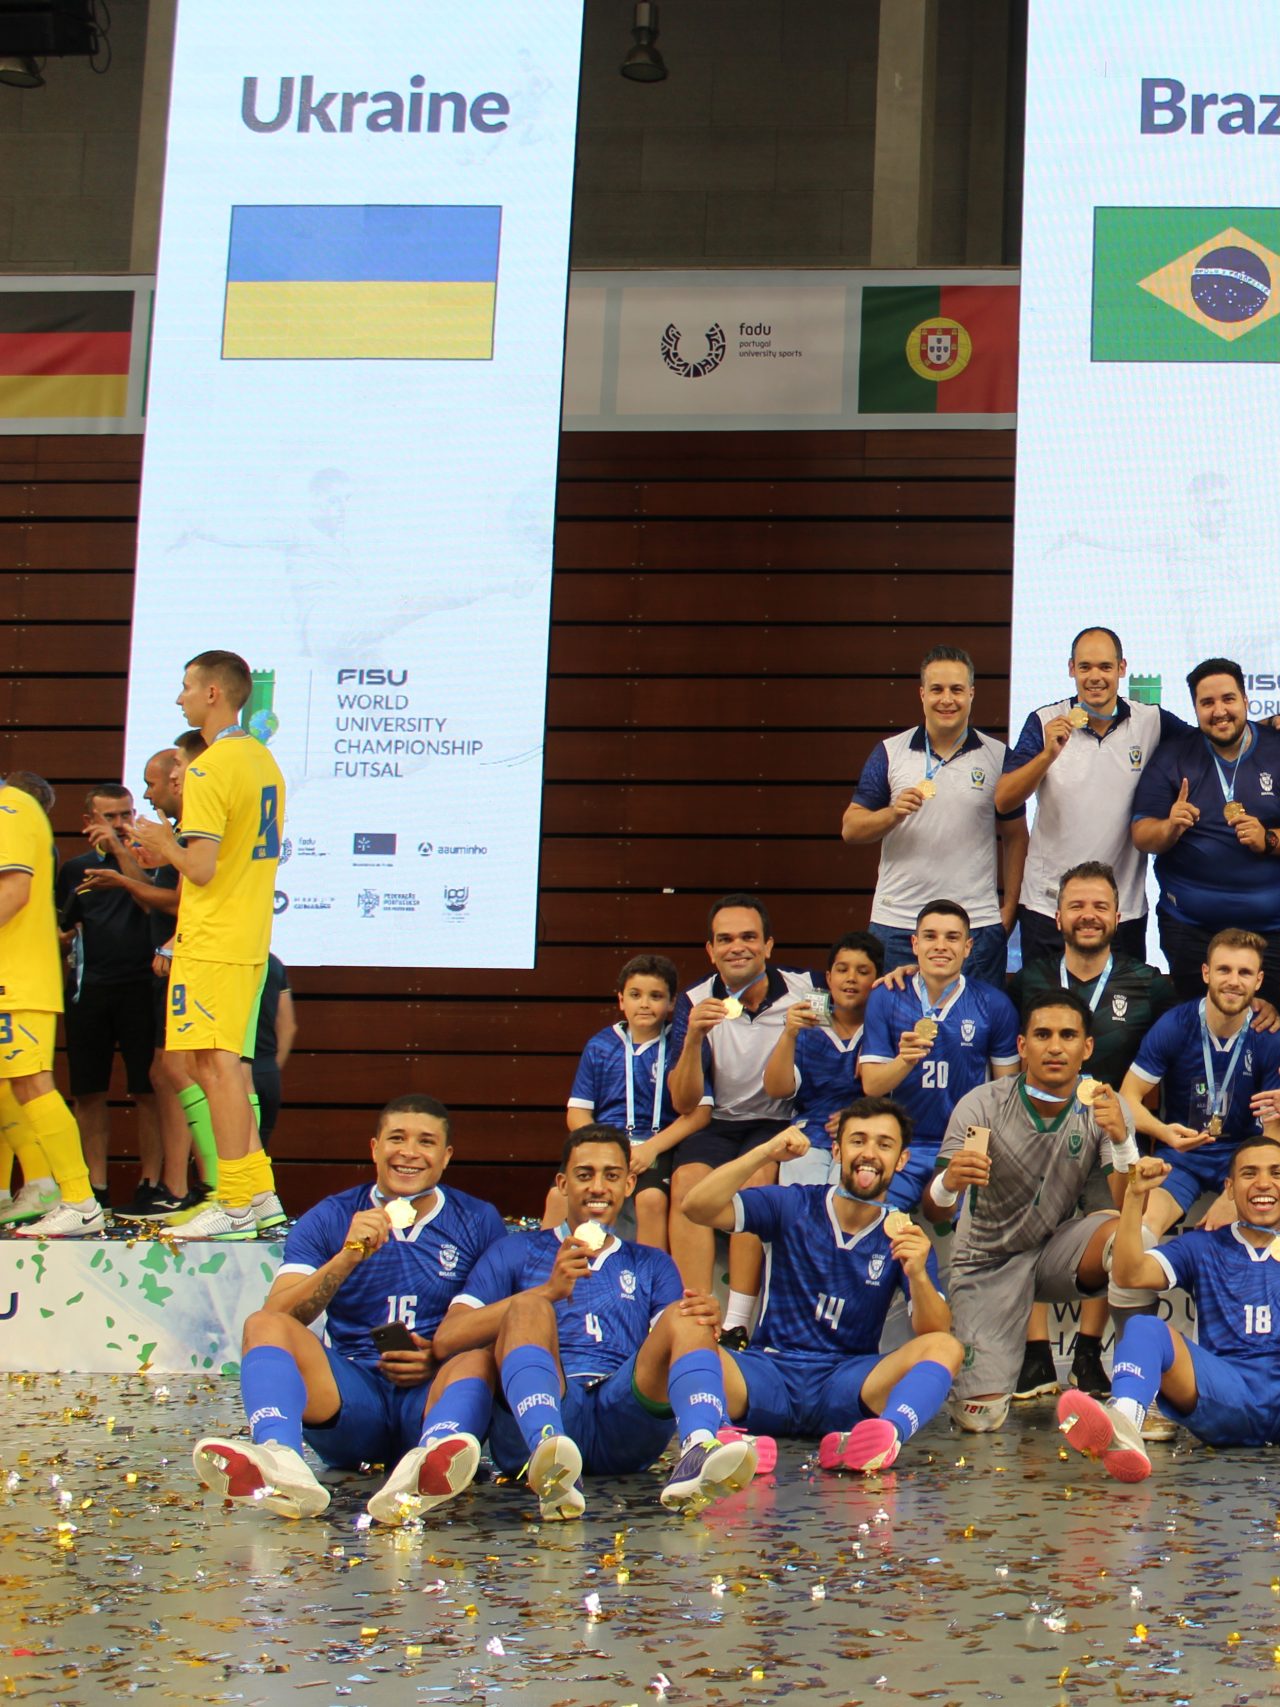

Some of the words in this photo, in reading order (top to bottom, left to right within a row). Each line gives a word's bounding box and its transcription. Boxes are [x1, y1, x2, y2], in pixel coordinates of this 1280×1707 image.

[241, 74, 510, 133] Ukraine
[739, 322, 771, 336] fadu
[739, 340, 771, 349] portugal
[739, 350, 776, 359] university
[778, 350, 802, 359] sports
[337, 669, 409, 687] FISU
[337, 694, 409, 711] WORLD
[335, 716, 448, 733] UNIVERSITY
[334, 738, 484, 756] CHAMPIONSHIP
[334, 761, 404, 778] FUTSAL
[252, 785, 283, 861] 9
[171, 983, 187, 1016] 9
[922, 1060, 949, 1089] 20
[387, 1295, 418, 1331] 16
[815, 1292, 846, 1330] 14
[1243, 1304, 1272, 1335] 18
[585, 1312, 603, 1343] 4
[517, 1392, 560, 1418] BRASIL
